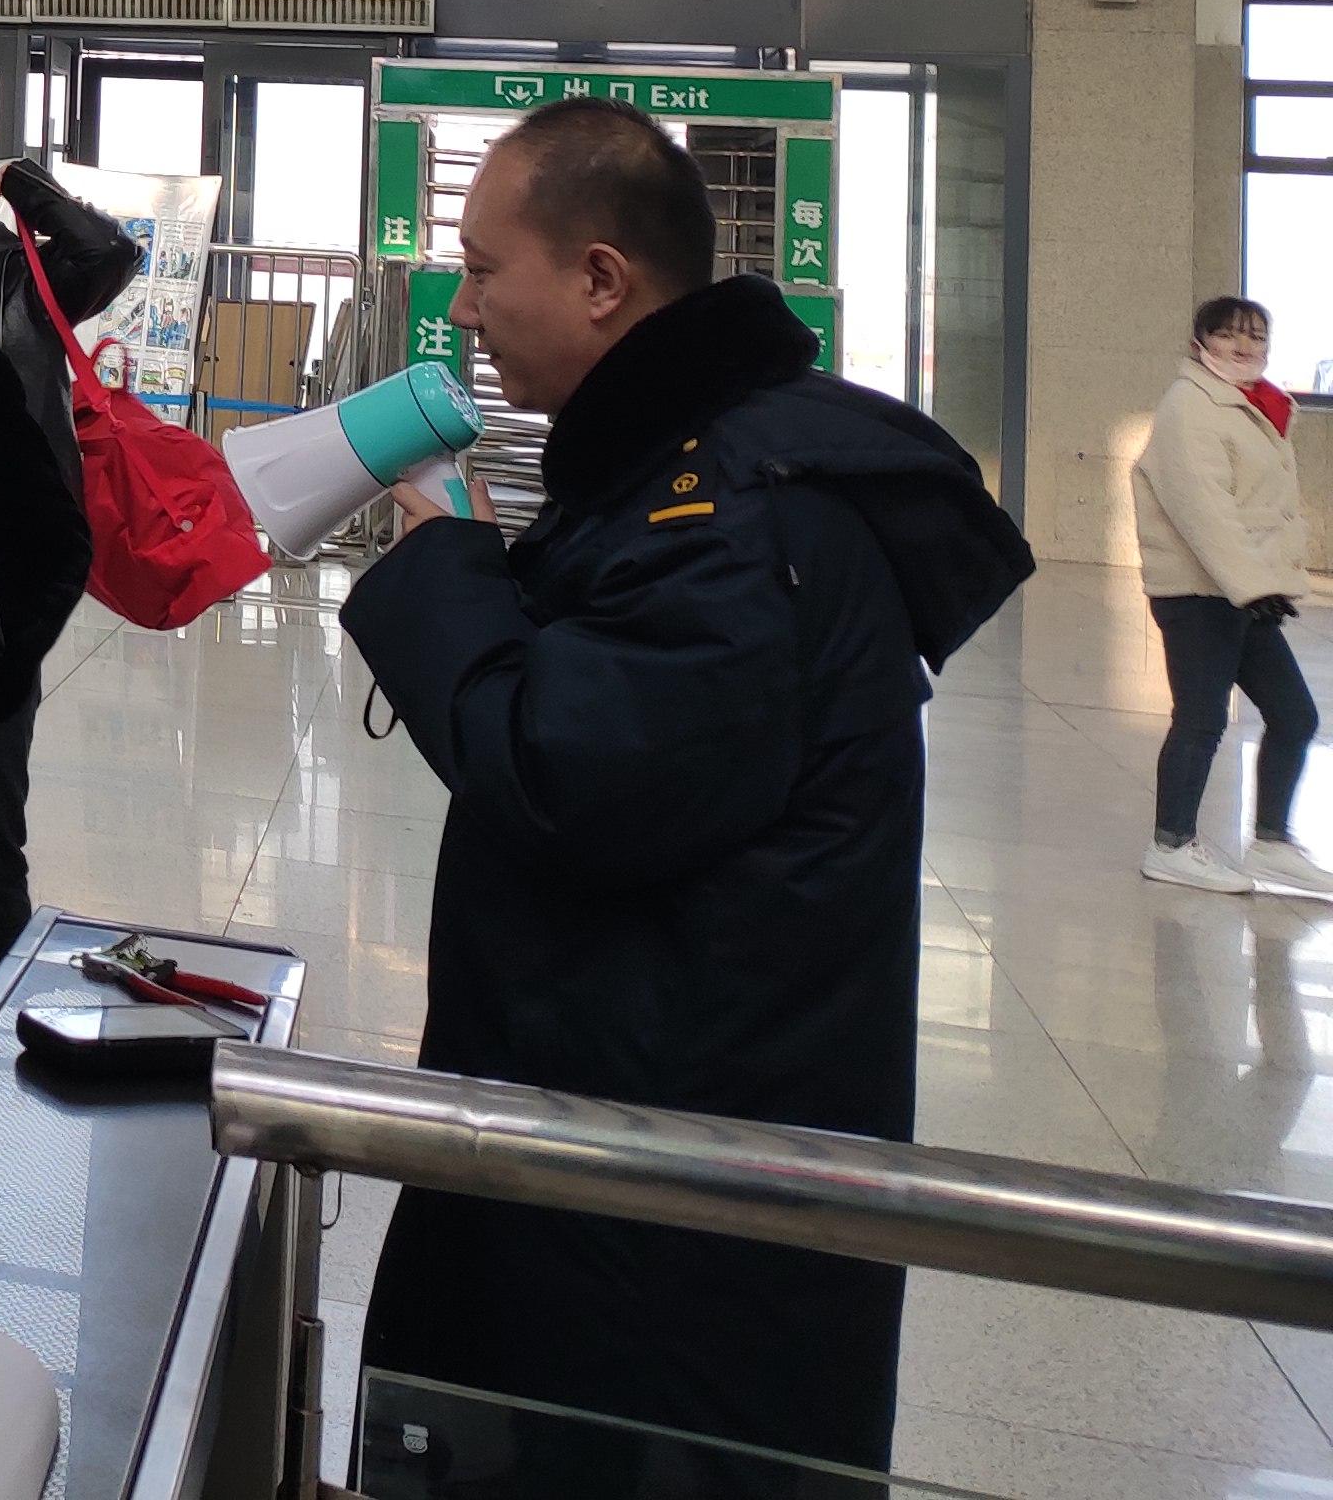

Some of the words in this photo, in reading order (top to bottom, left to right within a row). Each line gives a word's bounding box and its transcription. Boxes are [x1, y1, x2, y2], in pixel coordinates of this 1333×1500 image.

[563, 78, 634, 104] 出口
[650, 84, 710, 109] Exit
[383, 216, 411, 245] 注
[791, 199, 825, 286] 每次
[416, 316, 453, 357] 注
